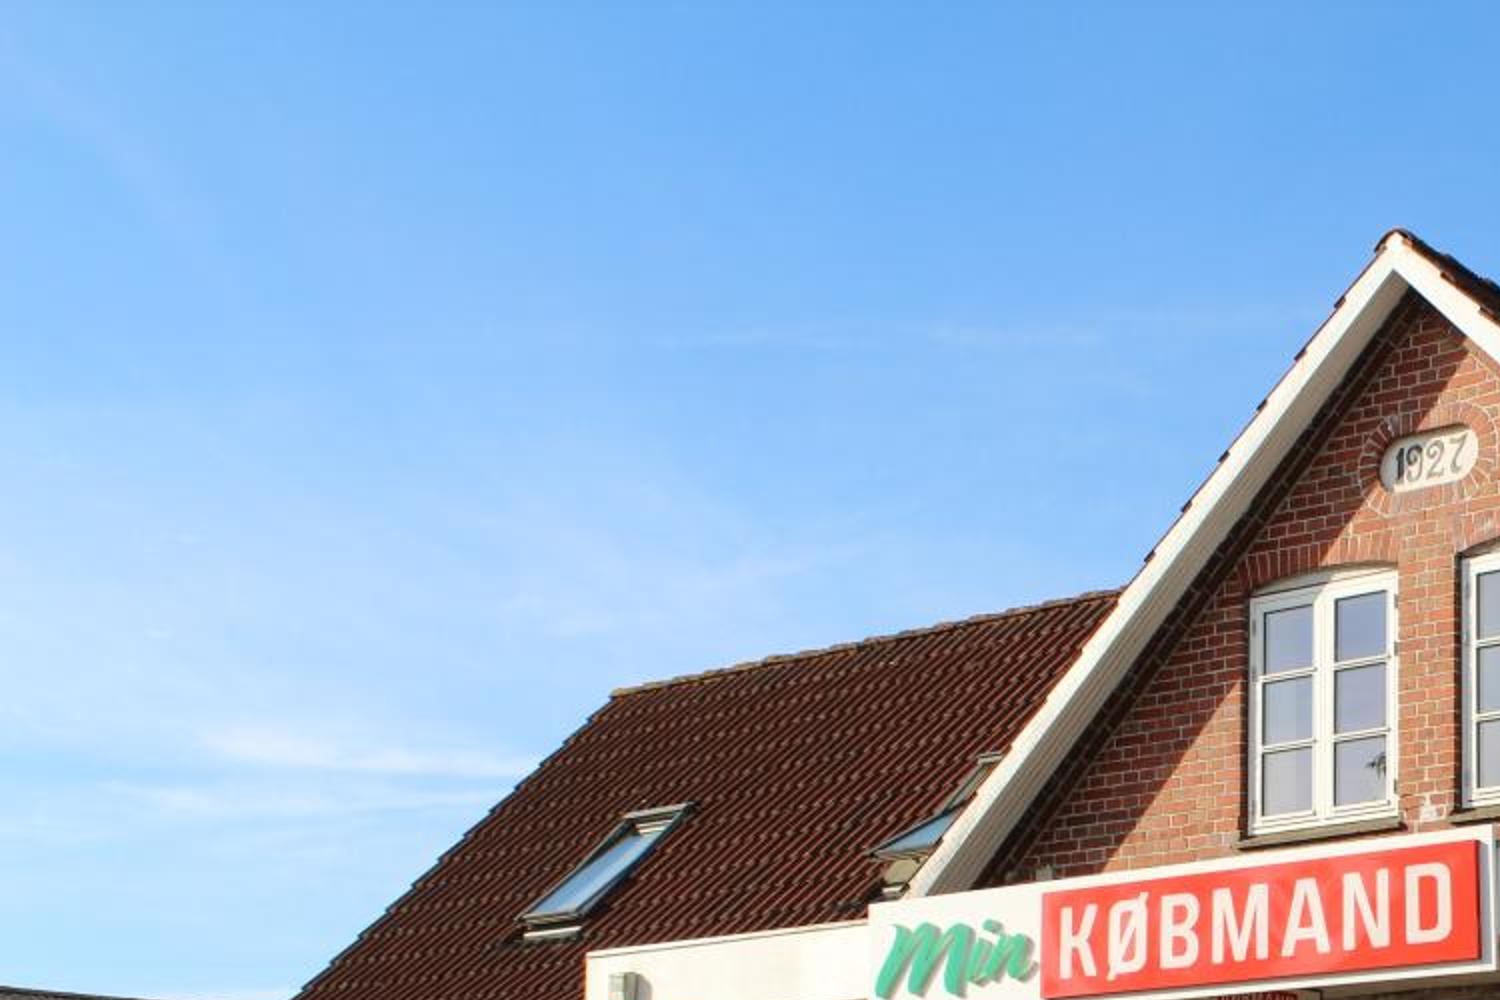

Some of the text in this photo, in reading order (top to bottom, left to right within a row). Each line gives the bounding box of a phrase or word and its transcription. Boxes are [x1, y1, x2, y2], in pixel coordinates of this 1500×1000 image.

[1395, 434, 1468, 484] 1927
[875, 861, 1453, 1000] Min KØBMAND
